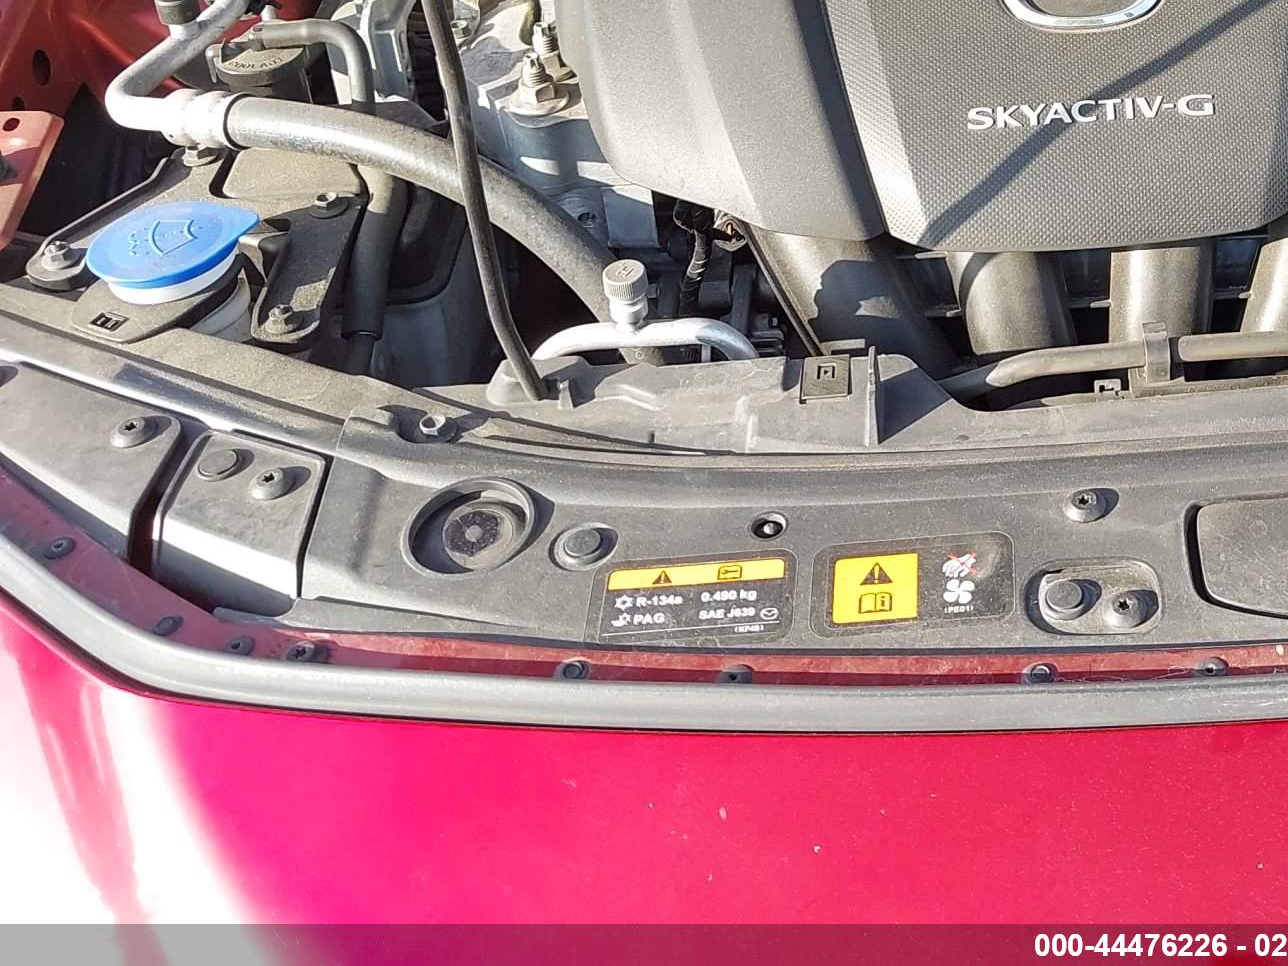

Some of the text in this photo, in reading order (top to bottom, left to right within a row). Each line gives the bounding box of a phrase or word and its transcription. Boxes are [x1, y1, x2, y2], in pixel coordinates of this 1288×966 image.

[967, 94, 1215, 130] SKYACTIV-G
[636, 589, 758, 607] R-134a 0.490 kg
[633, 612, 665, 625] PAG
[699, 609, 725, 620] SAE
